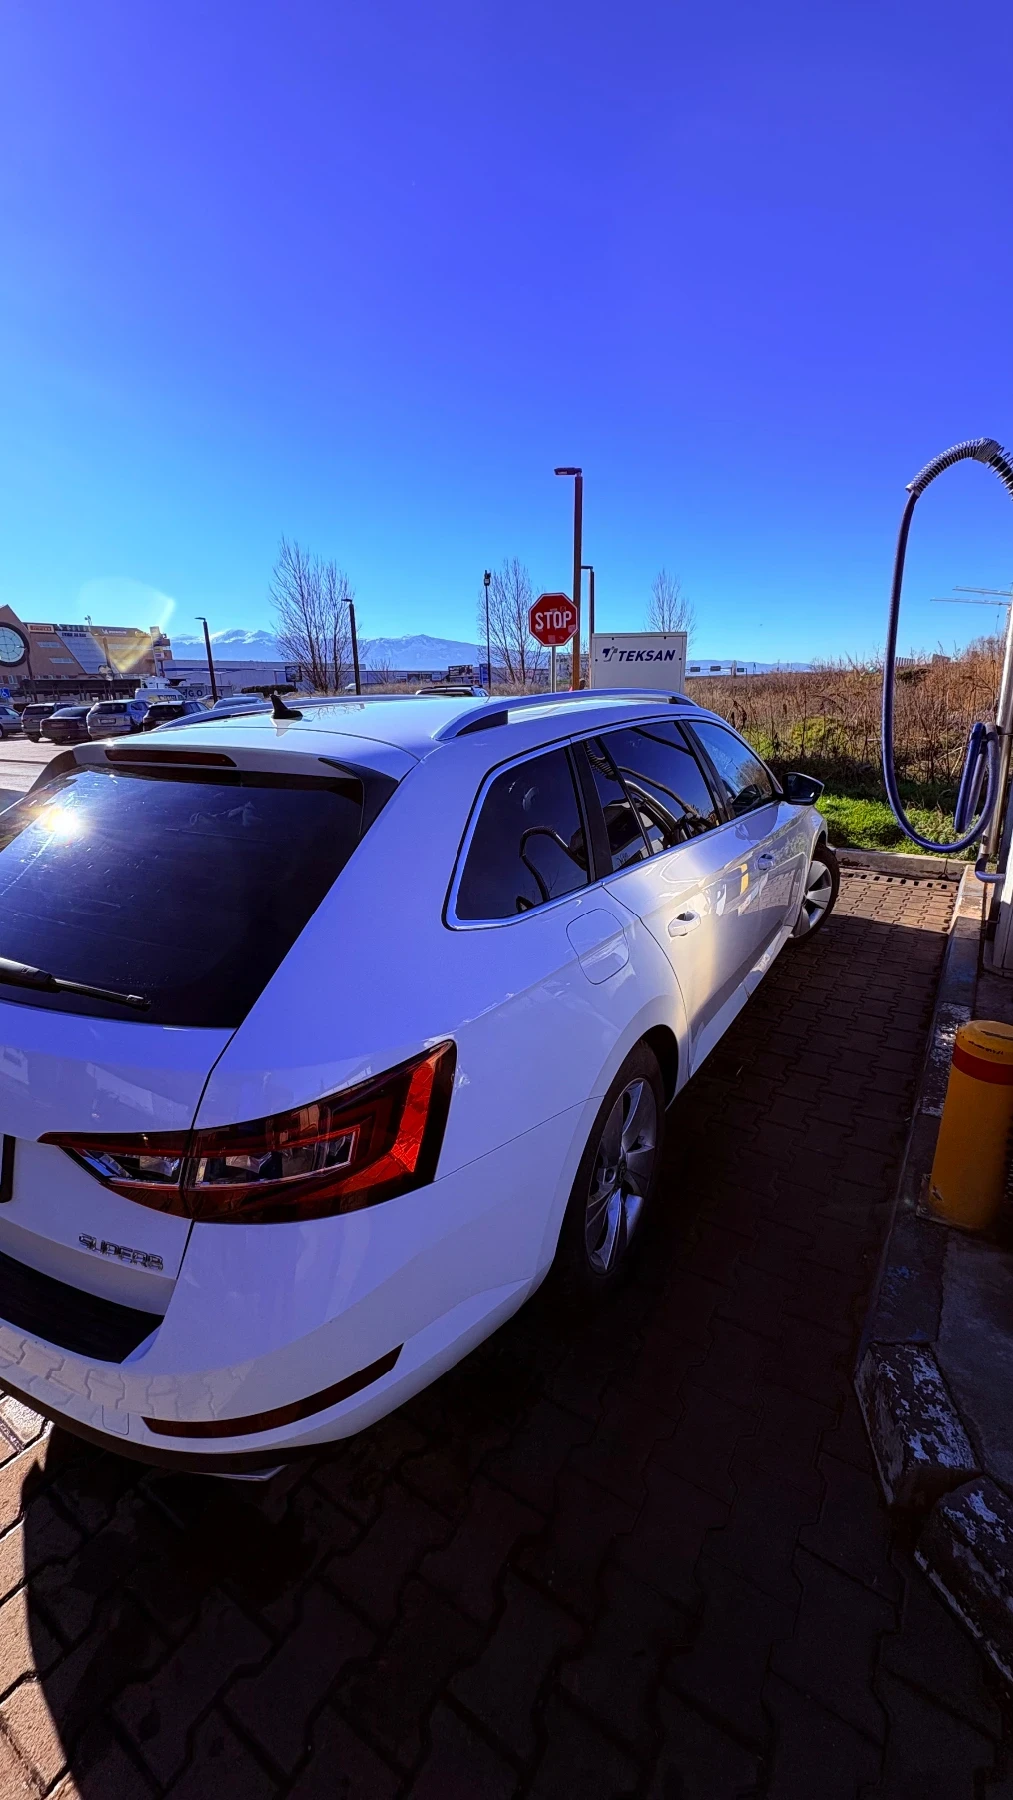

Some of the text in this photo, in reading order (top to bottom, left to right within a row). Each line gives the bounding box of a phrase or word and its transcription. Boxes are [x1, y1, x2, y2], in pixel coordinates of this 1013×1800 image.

[535, 610, 572, 630] STOP
[618, 649, 676, 662] TEKSAN
[78, 1232, 164, 1271] SUPERB
